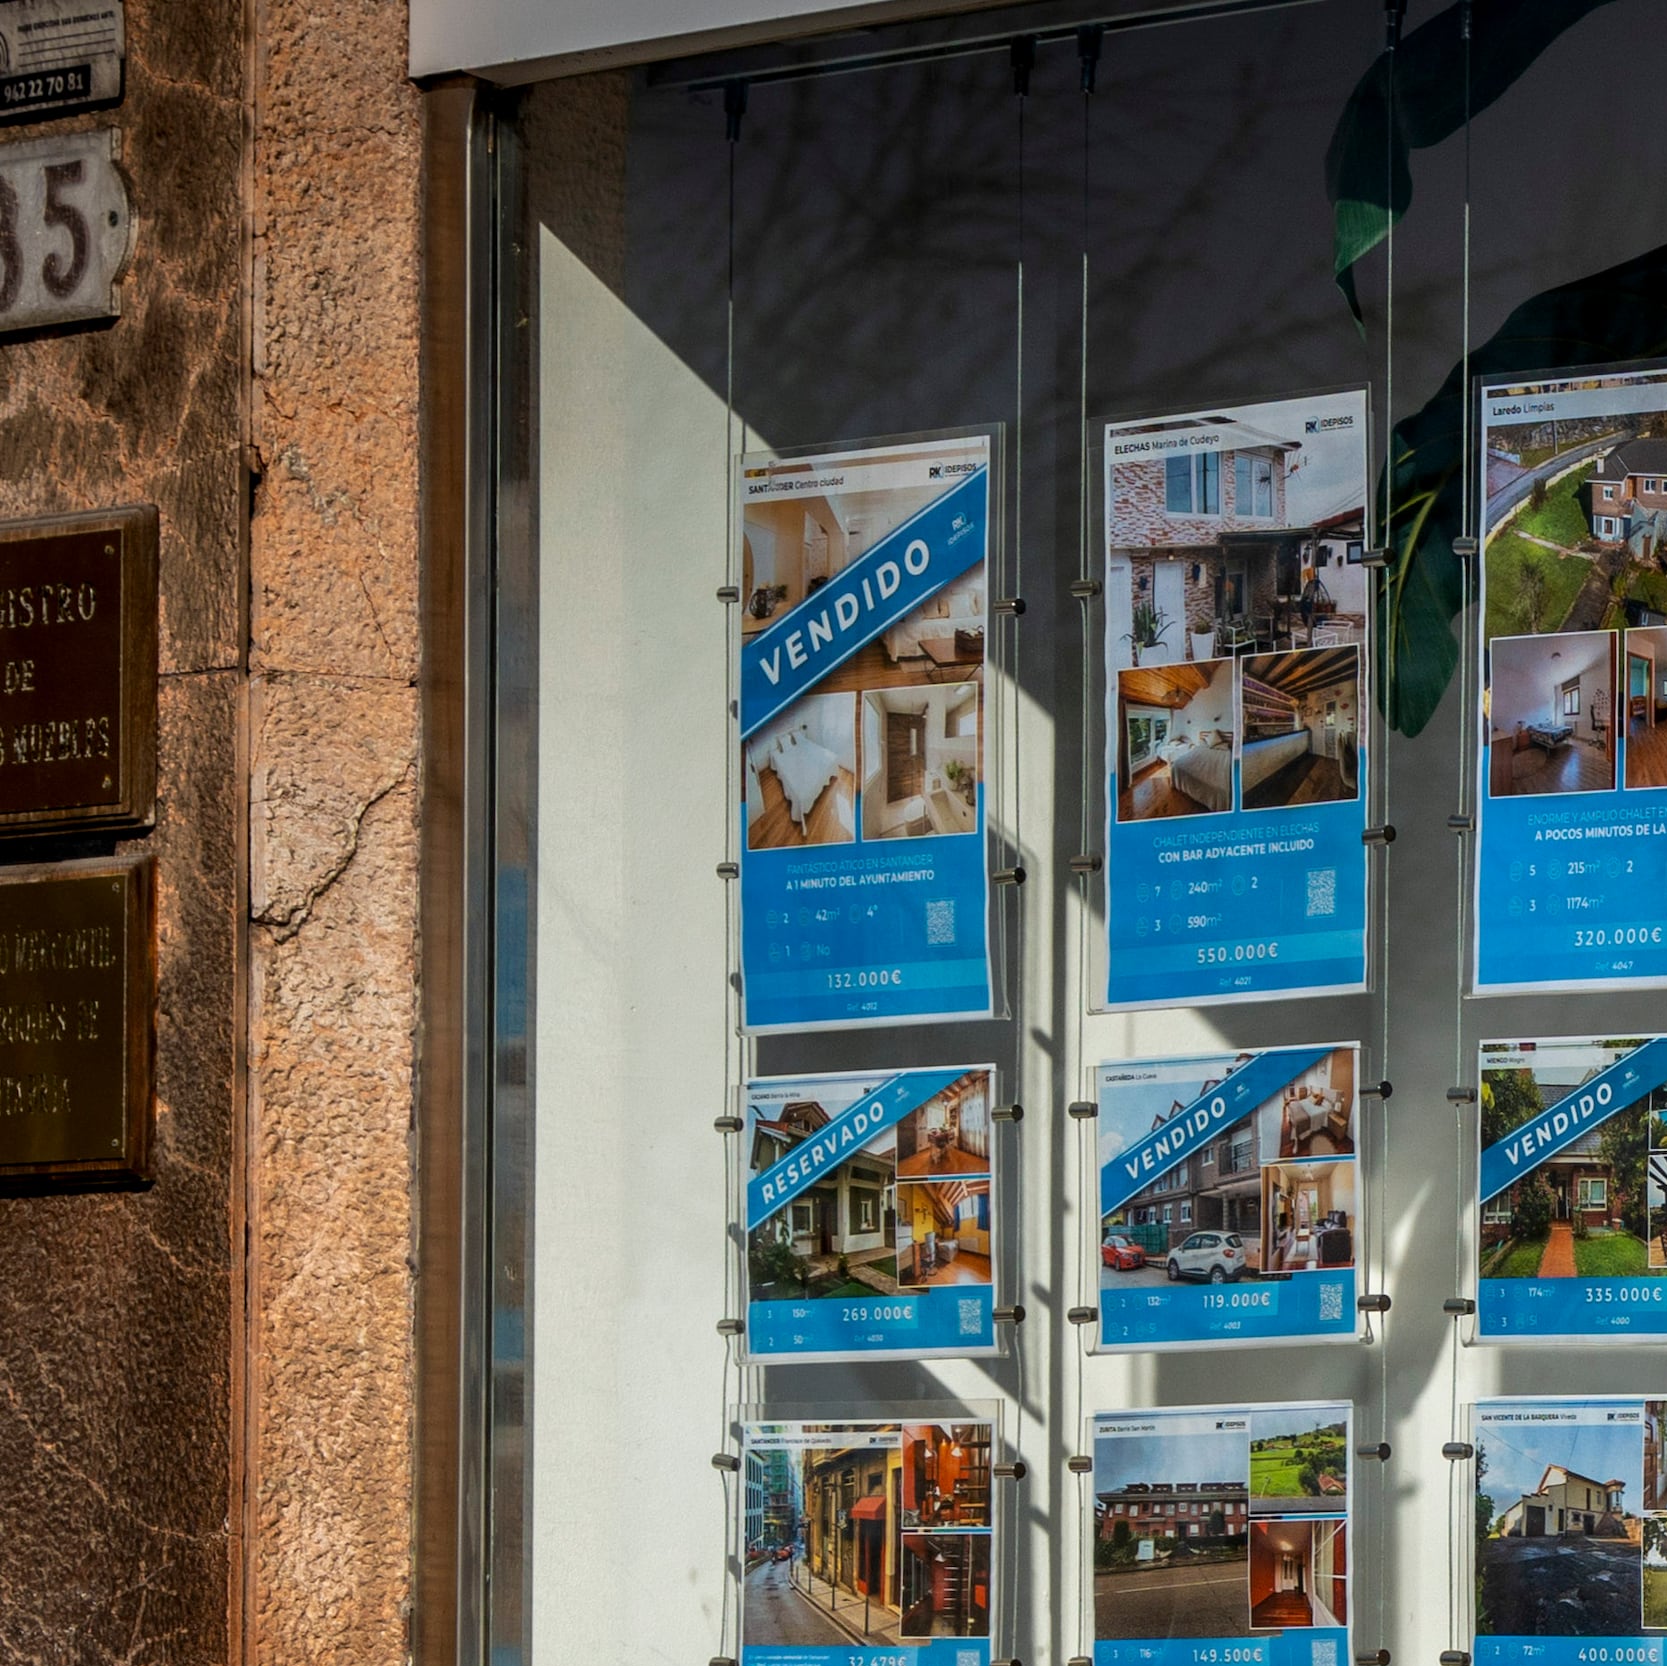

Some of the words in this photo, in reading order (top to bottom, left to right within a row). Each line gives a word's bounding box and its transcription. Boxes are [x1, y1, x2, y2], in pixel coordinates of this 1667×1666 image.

[28, 78, 42, 98] 22
[46, 75, 64, 95] 70
[67, 73, 83, 91] 81
[1493, 406, 1521, 416] Laredo
[1115, 442, 1150, 455] ELECHAS
[1152, 440, 1177, 451] Marina
[1179, 437, 1188, 447] de
[1190, 434, 1219, 447] Cudeyo
[0, 583, 96, 629] ISTRO
[760, 539, 930, 685] VENDIDO
[1158, 851, 1180, 863] CON
[1183, 850, 1203, 861] BAR
[1205, 844, 1265, 859] ADYACENTE
[1269, 839, 1314, 852] INCLUIDO
[1575, 927, 1662, 946] 320.000€
[1198, 943, 1279, 963] 550.000€
[828, 970, 901, 988] 132.000€
[1505, 1083, 1612, 1166] VENDIDO
[1125, 1097, 1226, 1179] VENDIDO
[762, 1102, 883, 1204] RESERVADO
[1203, 1292, 1270, 1309] 119.000€
[1586, 1287, 1663, 1302] 335.000€
[843, 1306, 913, 1321] 269.000€
[1193, 1648, 1262, 1663] 149.500€
[1579, 1648, 1658, 1662] 400.000€
